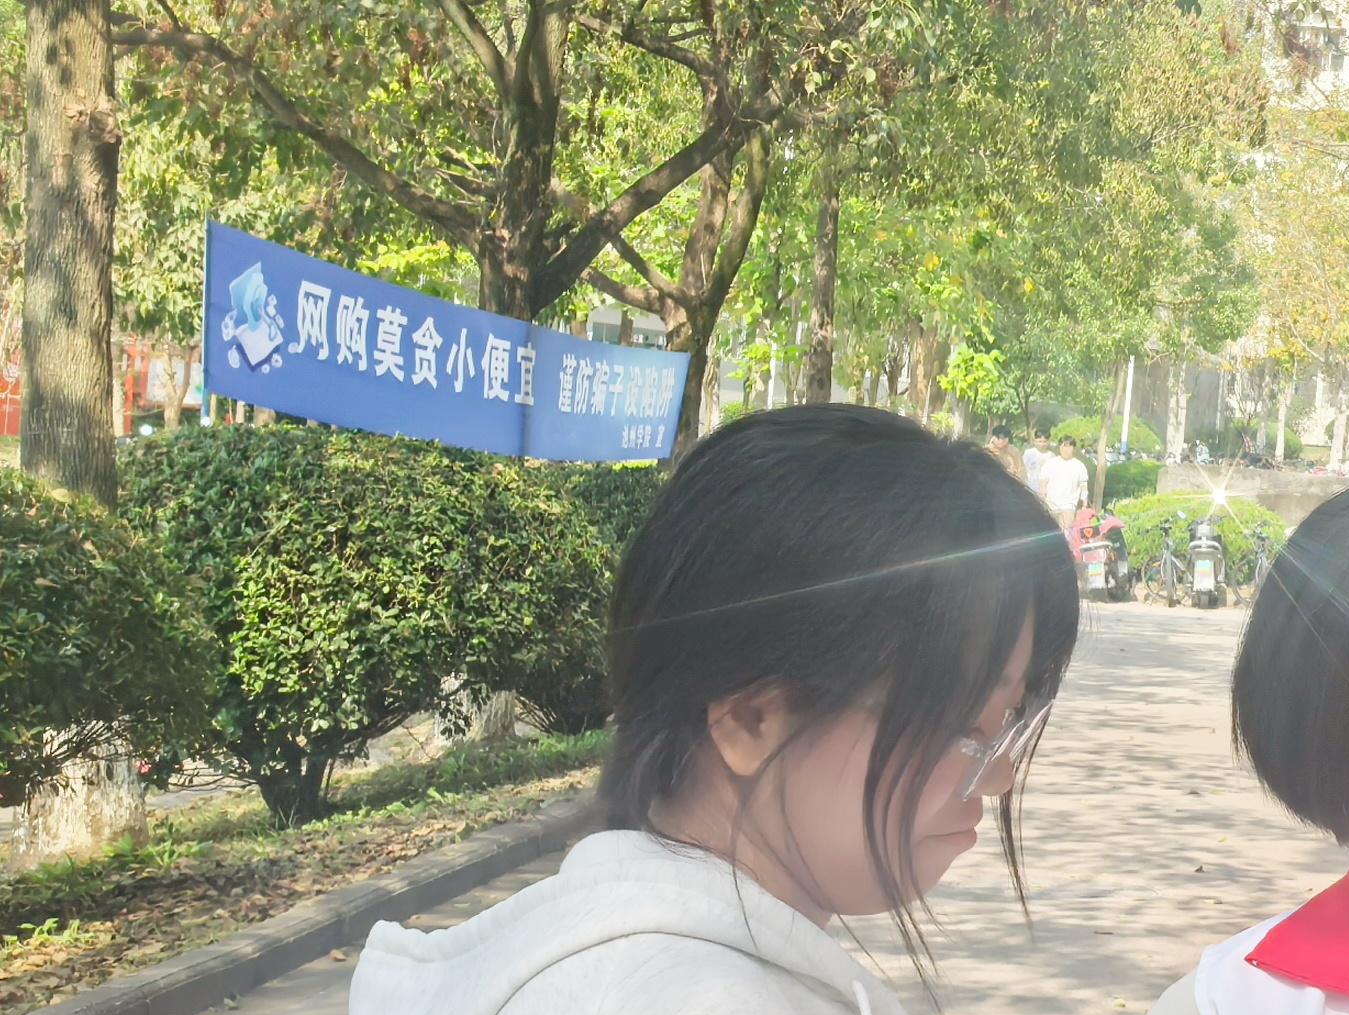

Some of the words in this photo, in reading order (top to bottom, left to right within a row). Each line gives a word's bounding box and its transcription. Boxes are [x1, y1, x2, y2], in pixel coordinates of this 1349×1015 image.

[296, 279, 537, 406] 网购莫贪小便宜
